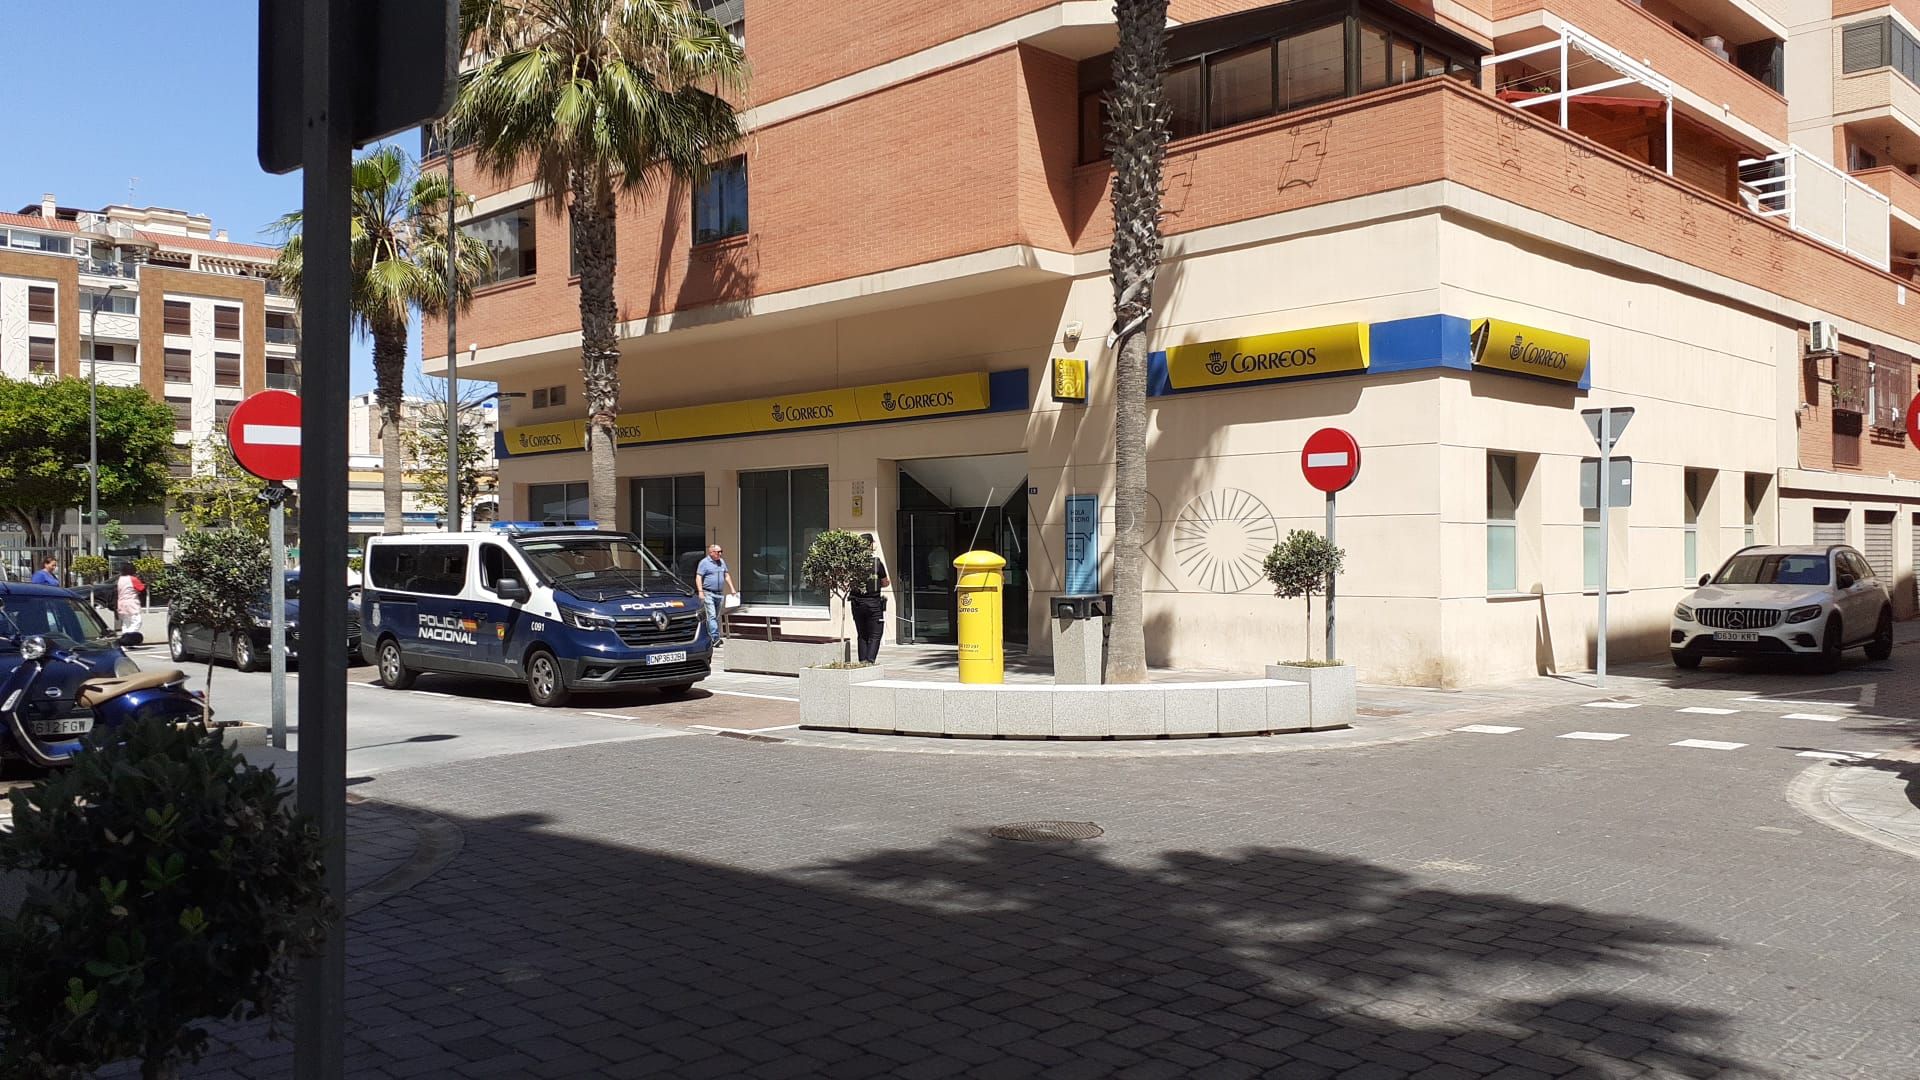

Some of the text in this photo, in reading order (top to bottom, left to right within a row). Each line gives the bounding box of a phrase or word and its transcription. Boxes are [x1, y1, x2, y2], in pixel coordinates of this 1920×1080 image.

[1230, 347, 1317, 374] CORREOS
[1522, 342, 1569, 370] CORREOS
[897, 391, 955, 411] CORREOS
[785, 404, 834, 422] CORREOS
[528, 433, 562, 448] CORREOS
[615, 425, 641, 439] RREOS
[620, 601, 674, 612] POLICIA
[418, 613, 465, 631] POLICIA
[418, 626, 478, 646] NACIONAL
[1740, 633, 1757, 641] KRT
[36, 720, 86, 734] 612FGW
